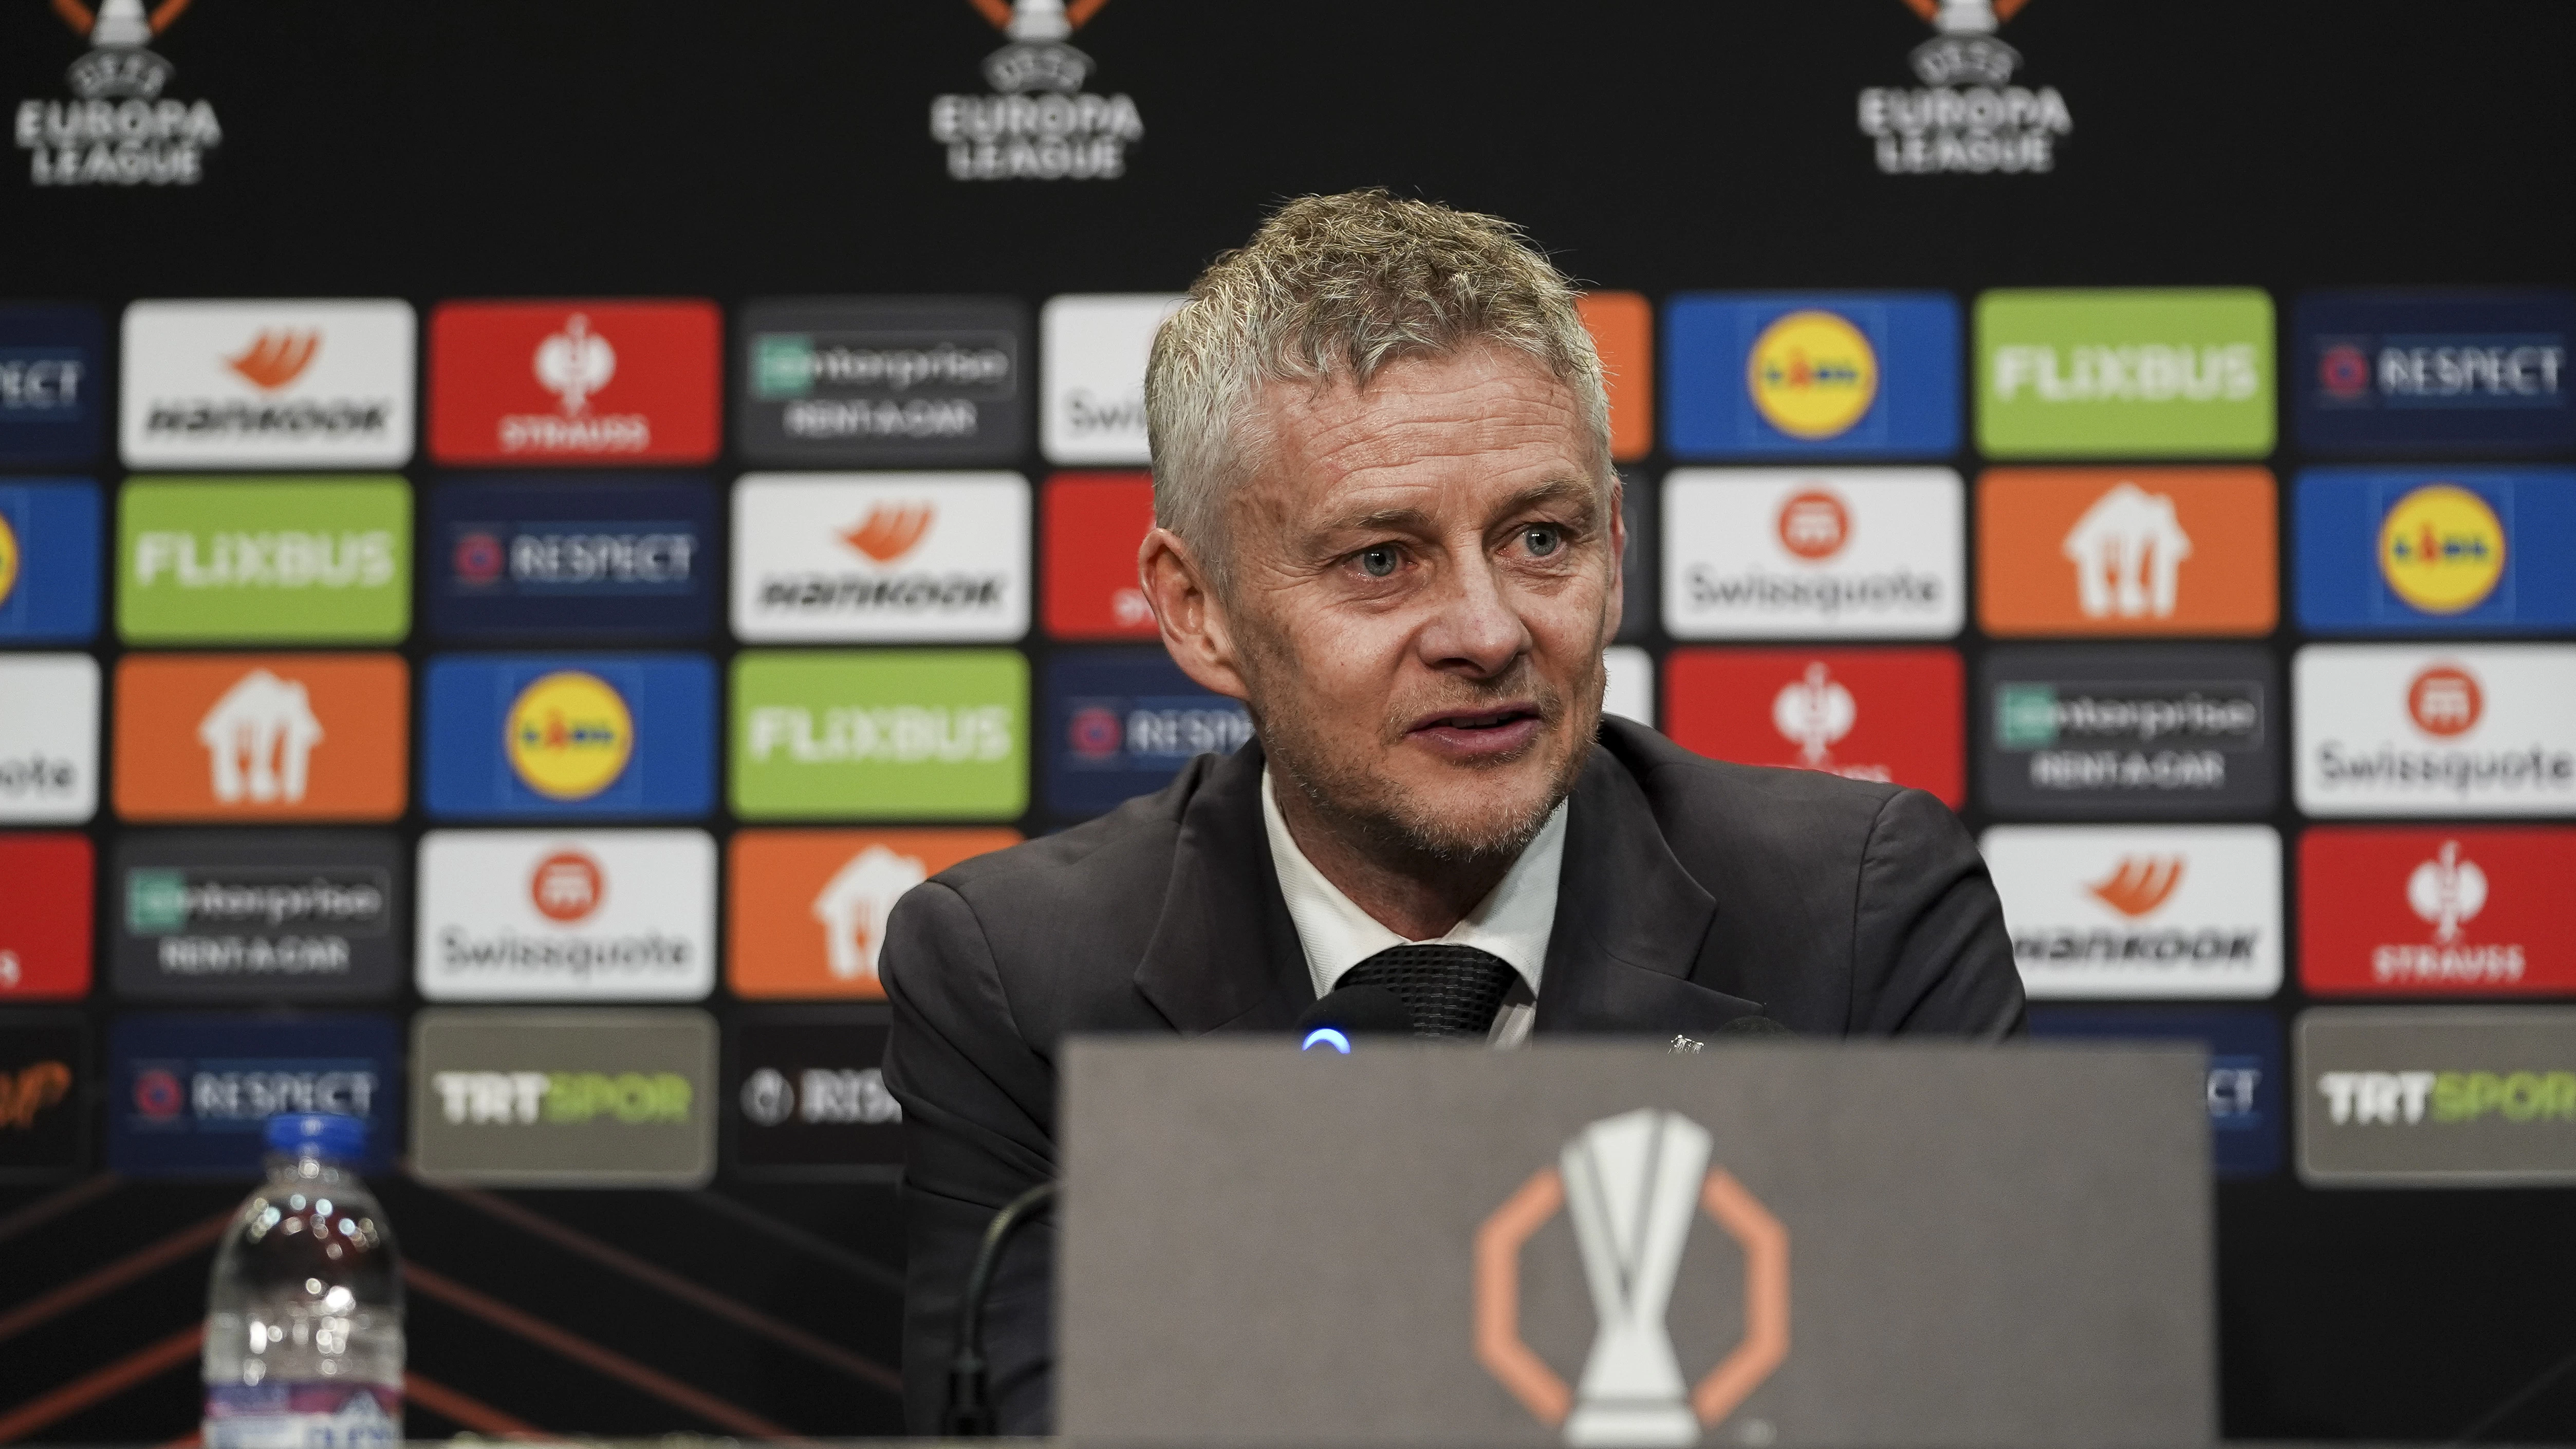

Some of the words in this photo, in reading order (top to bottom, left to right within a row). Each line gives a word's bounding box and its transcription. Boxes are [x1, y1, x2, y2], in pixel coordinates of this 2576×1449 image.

[15, 99, 221, 147] EUROPA
[931, 95, 1144, 142] EUROPA
[1859, 87, 2072, 135] EUROPA
[32, 146, 203, 185] LEAGUE
[947, 140, 1126, 180] LEAGUE
[1876, 135, 2053, 173] LEAGUE
[0, 360, 84, 410] ECT
[2377, 347, 2566, 396] RESPECT
[498, 415, 650, 453] STRAUSS
[511, 534, 698, 583] RESPECT
[1688, 563, 1942, 617] Swissquote
[0, 751, 75, 797] ote
[2319, 740, 2575, 800] Swissquote
[439, 926, 692, 980] Swissquote
[2373, 944, 2525, 982] STRAUSS
[192, 1071, 379, 1120] RESPECT
